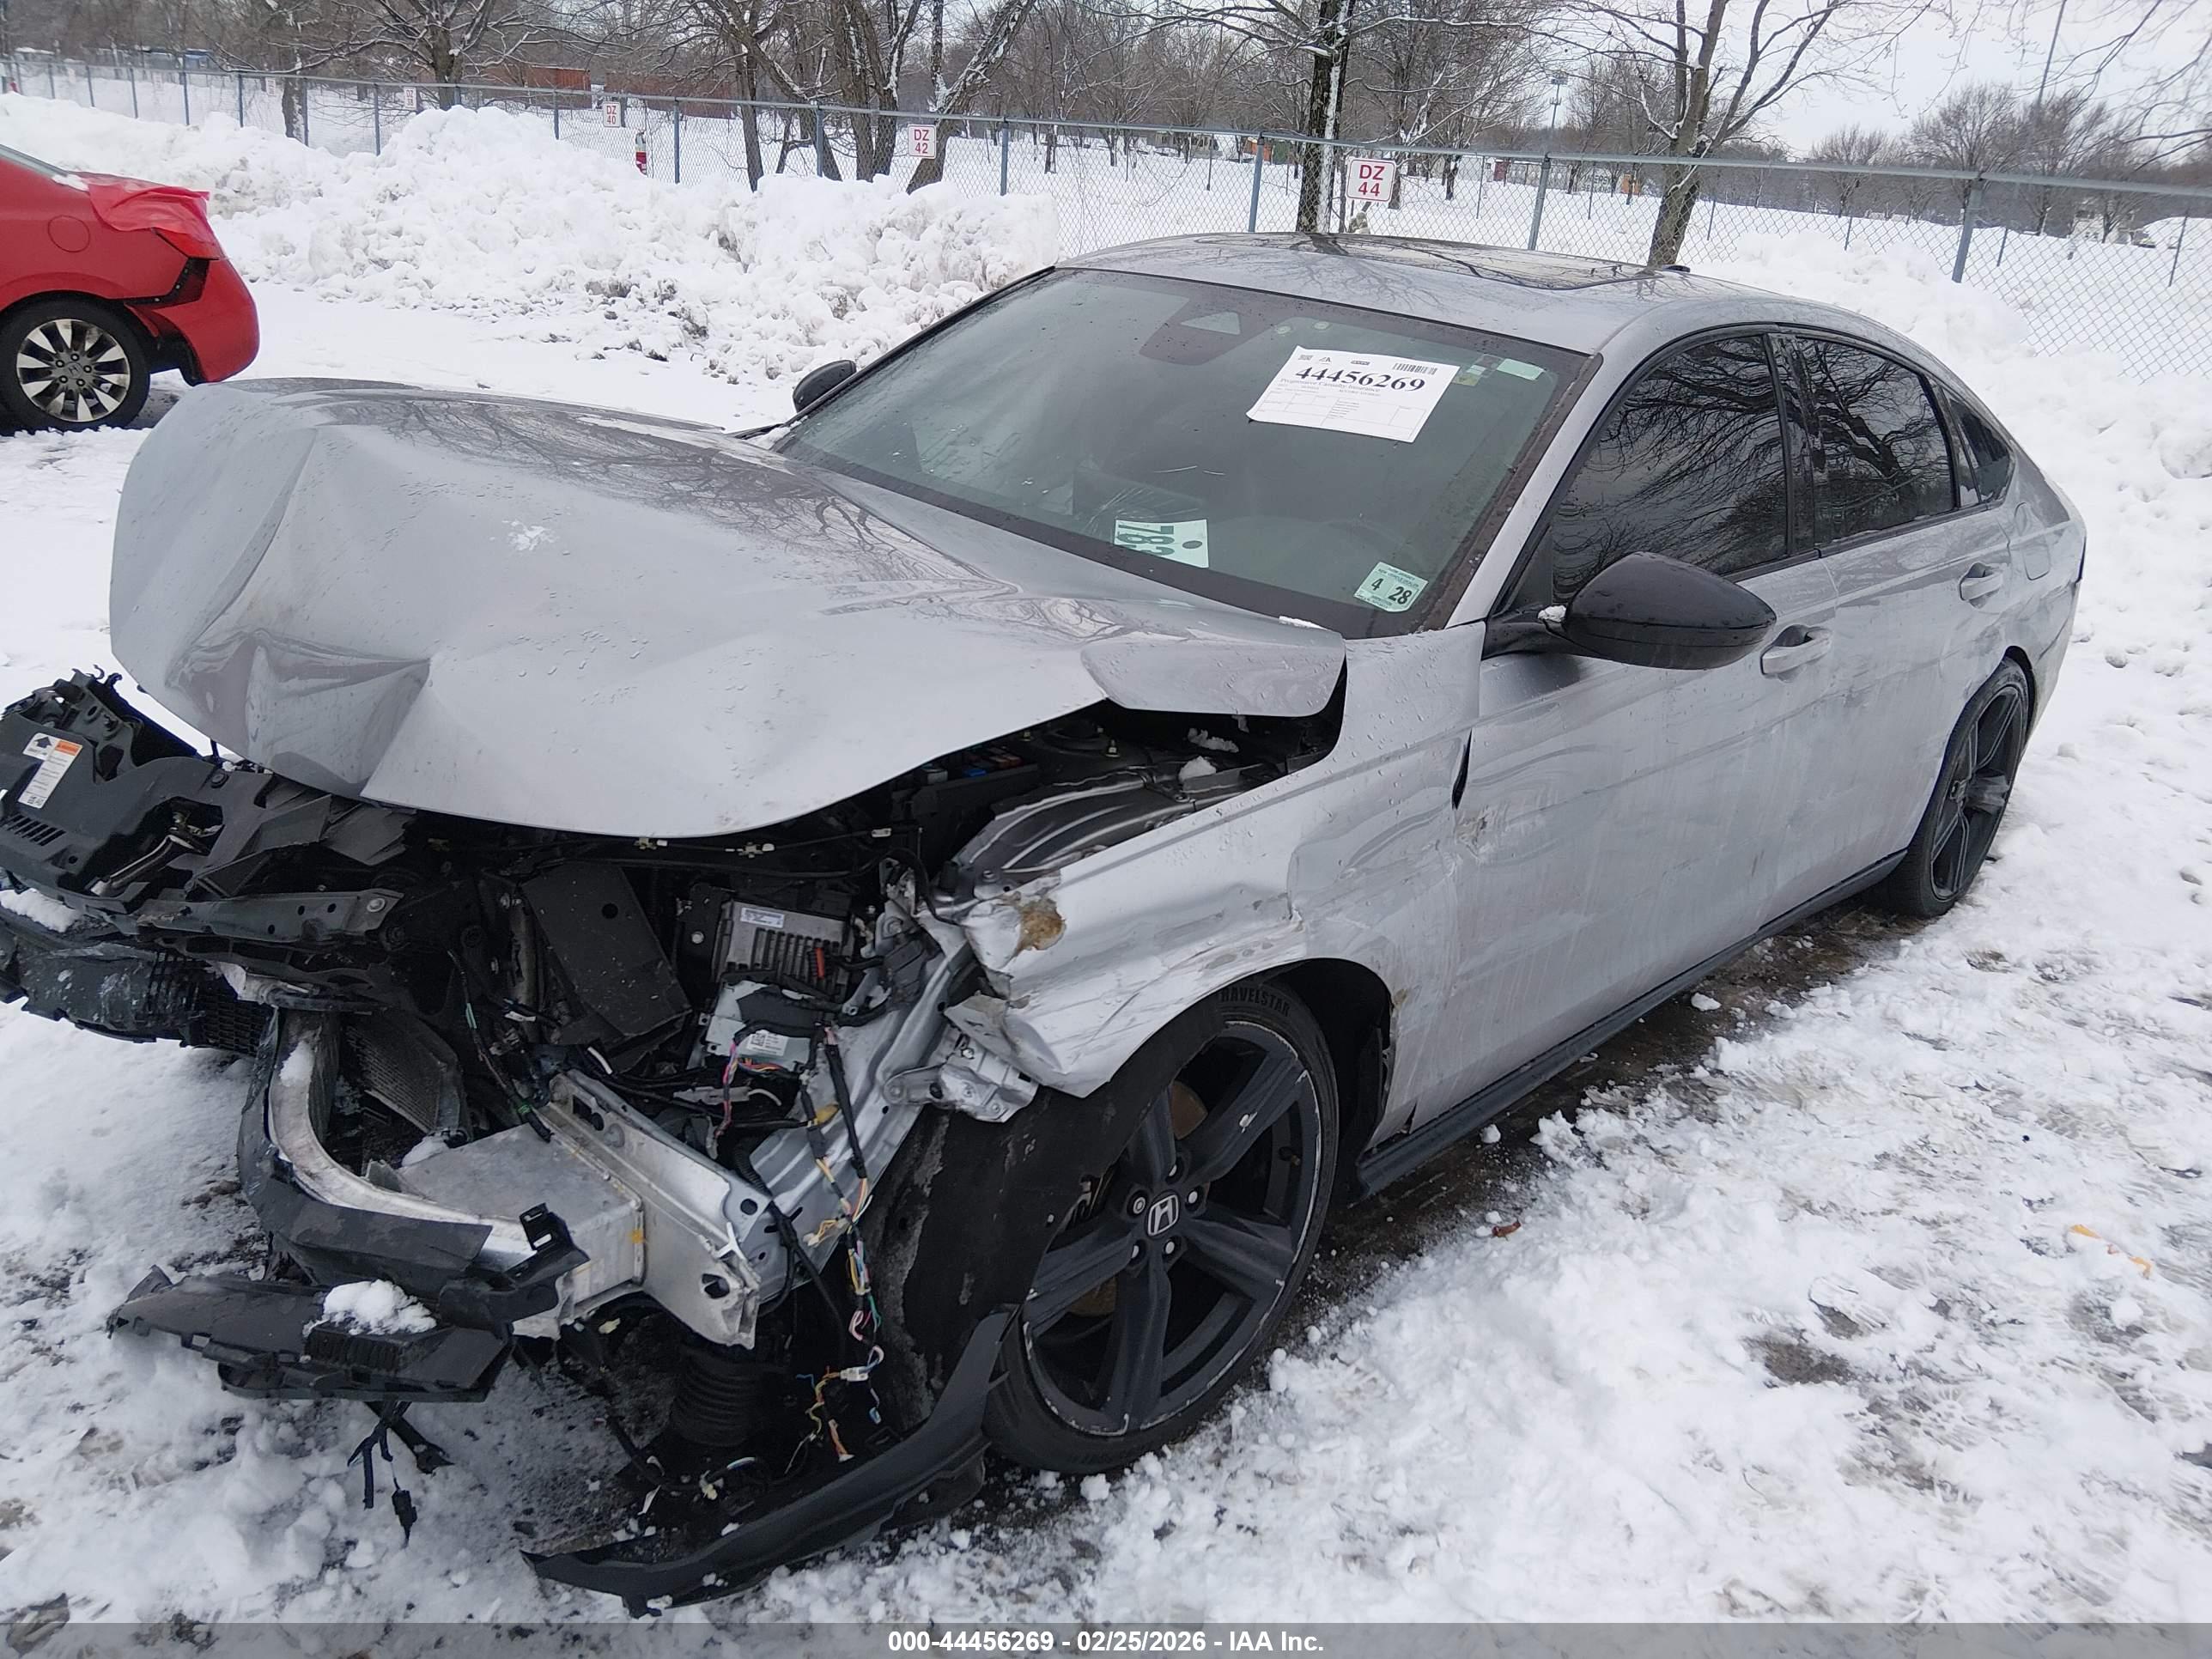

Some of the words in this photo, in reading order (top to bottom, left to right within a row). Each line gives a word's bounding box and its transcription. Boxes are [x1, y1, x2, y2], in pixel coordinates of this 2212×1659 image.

[606, 105, 617, 115] DZ
[606, 115, 617, 125] 40
[914, 129, 929, 141] DZ
[915, 143, 928, 154] 42
[1358, 164, 1385, 180] DZ
[1358, 181, 1381, 197] 44
[1295, 367, 1425, 392] 44456269
[1371, 578, 1383, 591] 4
[1388, 586, 1413, 605] 28
